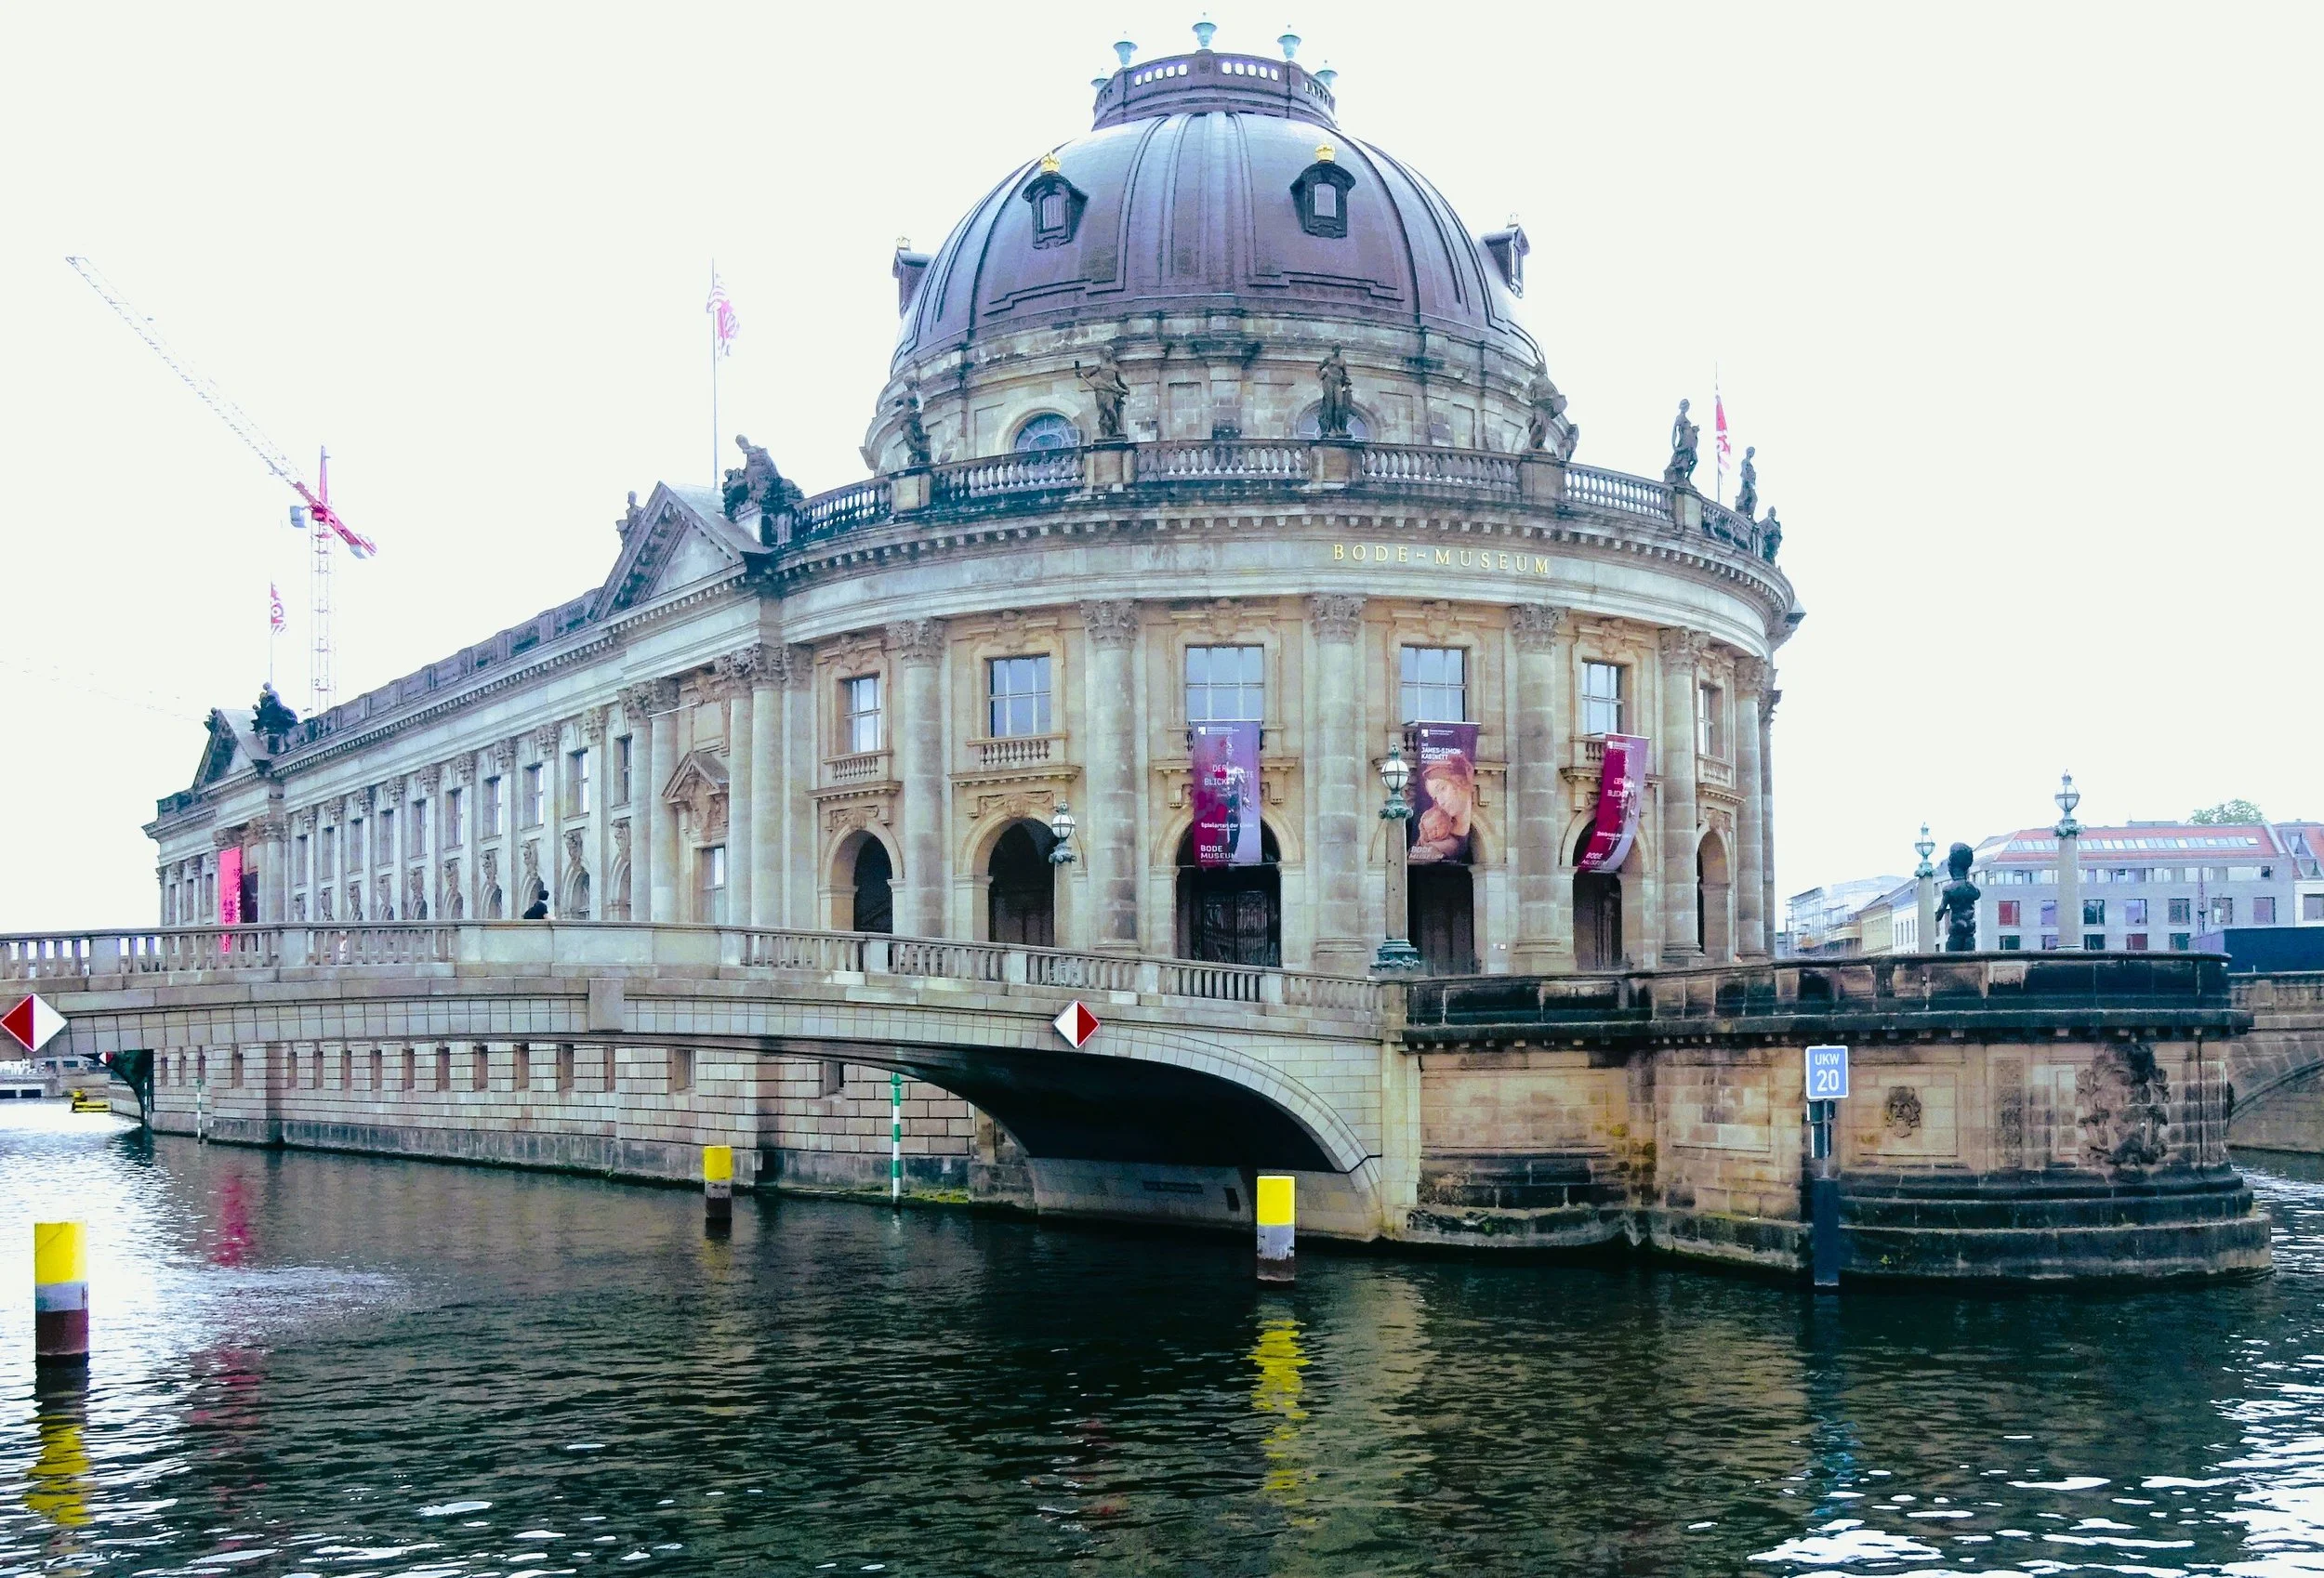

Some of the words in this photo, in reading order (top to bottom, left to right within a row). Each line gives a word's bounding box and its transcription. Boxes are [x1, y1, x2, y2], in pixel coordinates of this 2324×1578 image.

[1333, 544, 1550, 574] BODE-MUSEUM
[1204, 778, 1228, 786] BLICK
[1200, 845, 1223, 853] BODE
[1410, 845, 1433, 853] BODE
[1585, 851, 1604, 860] BODE
[1815, 1053, 1840, 1066] UKW
[1816, 1069, 1840, 1092] 20
